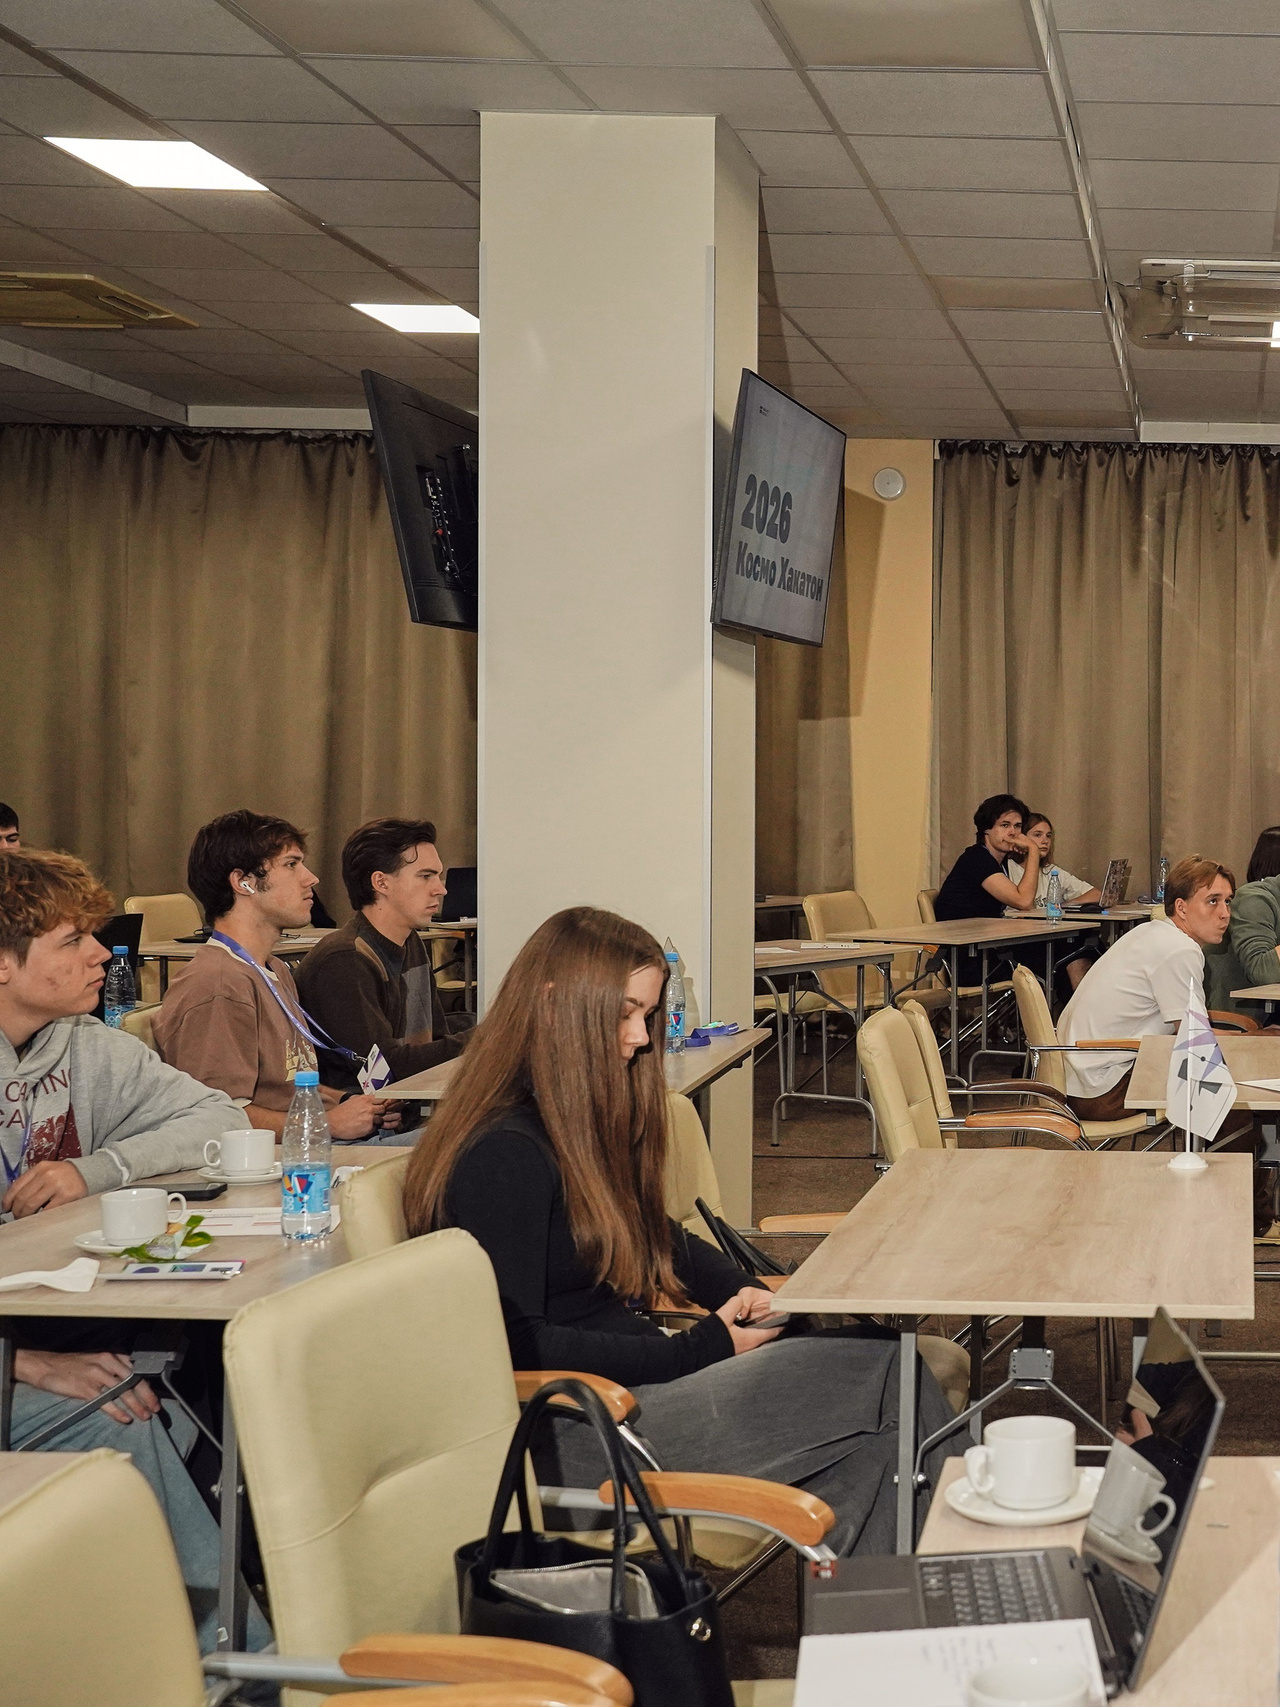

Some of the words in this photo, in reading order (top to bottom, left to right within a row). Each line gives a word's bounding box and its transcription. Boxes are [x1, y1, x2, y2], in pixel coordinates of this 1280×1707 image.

[741, 473, 793, 544] 2026
[735, 540, 777, 587] Космо
[777, 556, 824, 602] Хакатон
